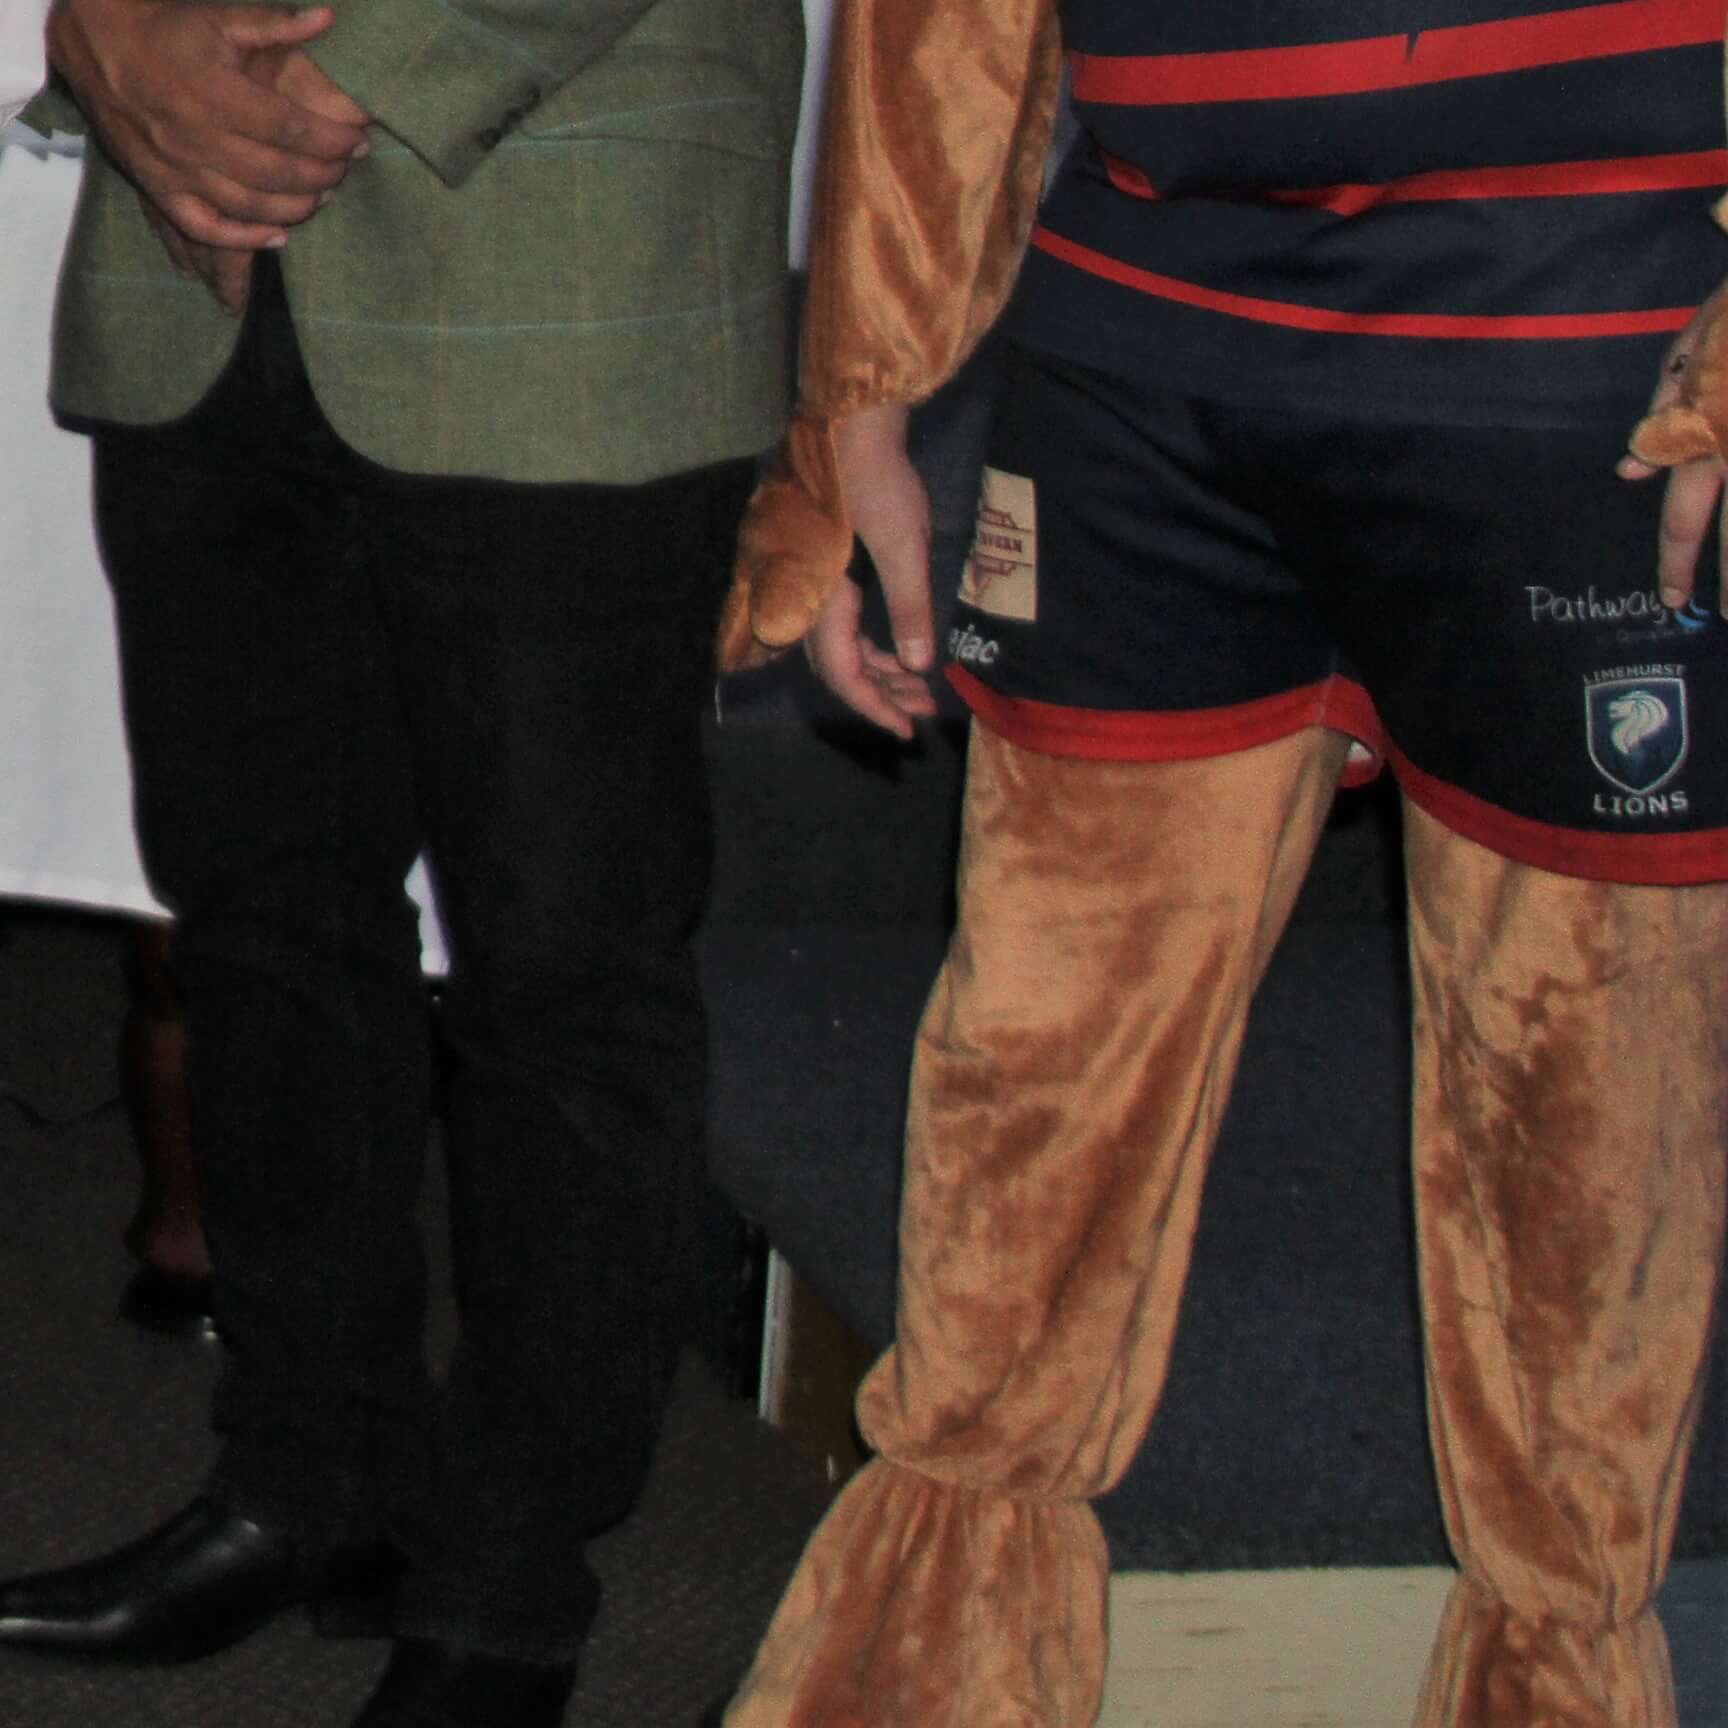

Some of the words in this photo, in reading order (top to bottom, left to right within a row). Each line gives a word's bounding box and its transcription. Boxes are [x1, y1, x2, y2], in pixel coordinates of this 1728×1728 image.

[948, 624, 999, 663] ejac
[1582, 663, 1686, 684] LIMEHURST
[1593, 790, 1688, 815] LIONS
